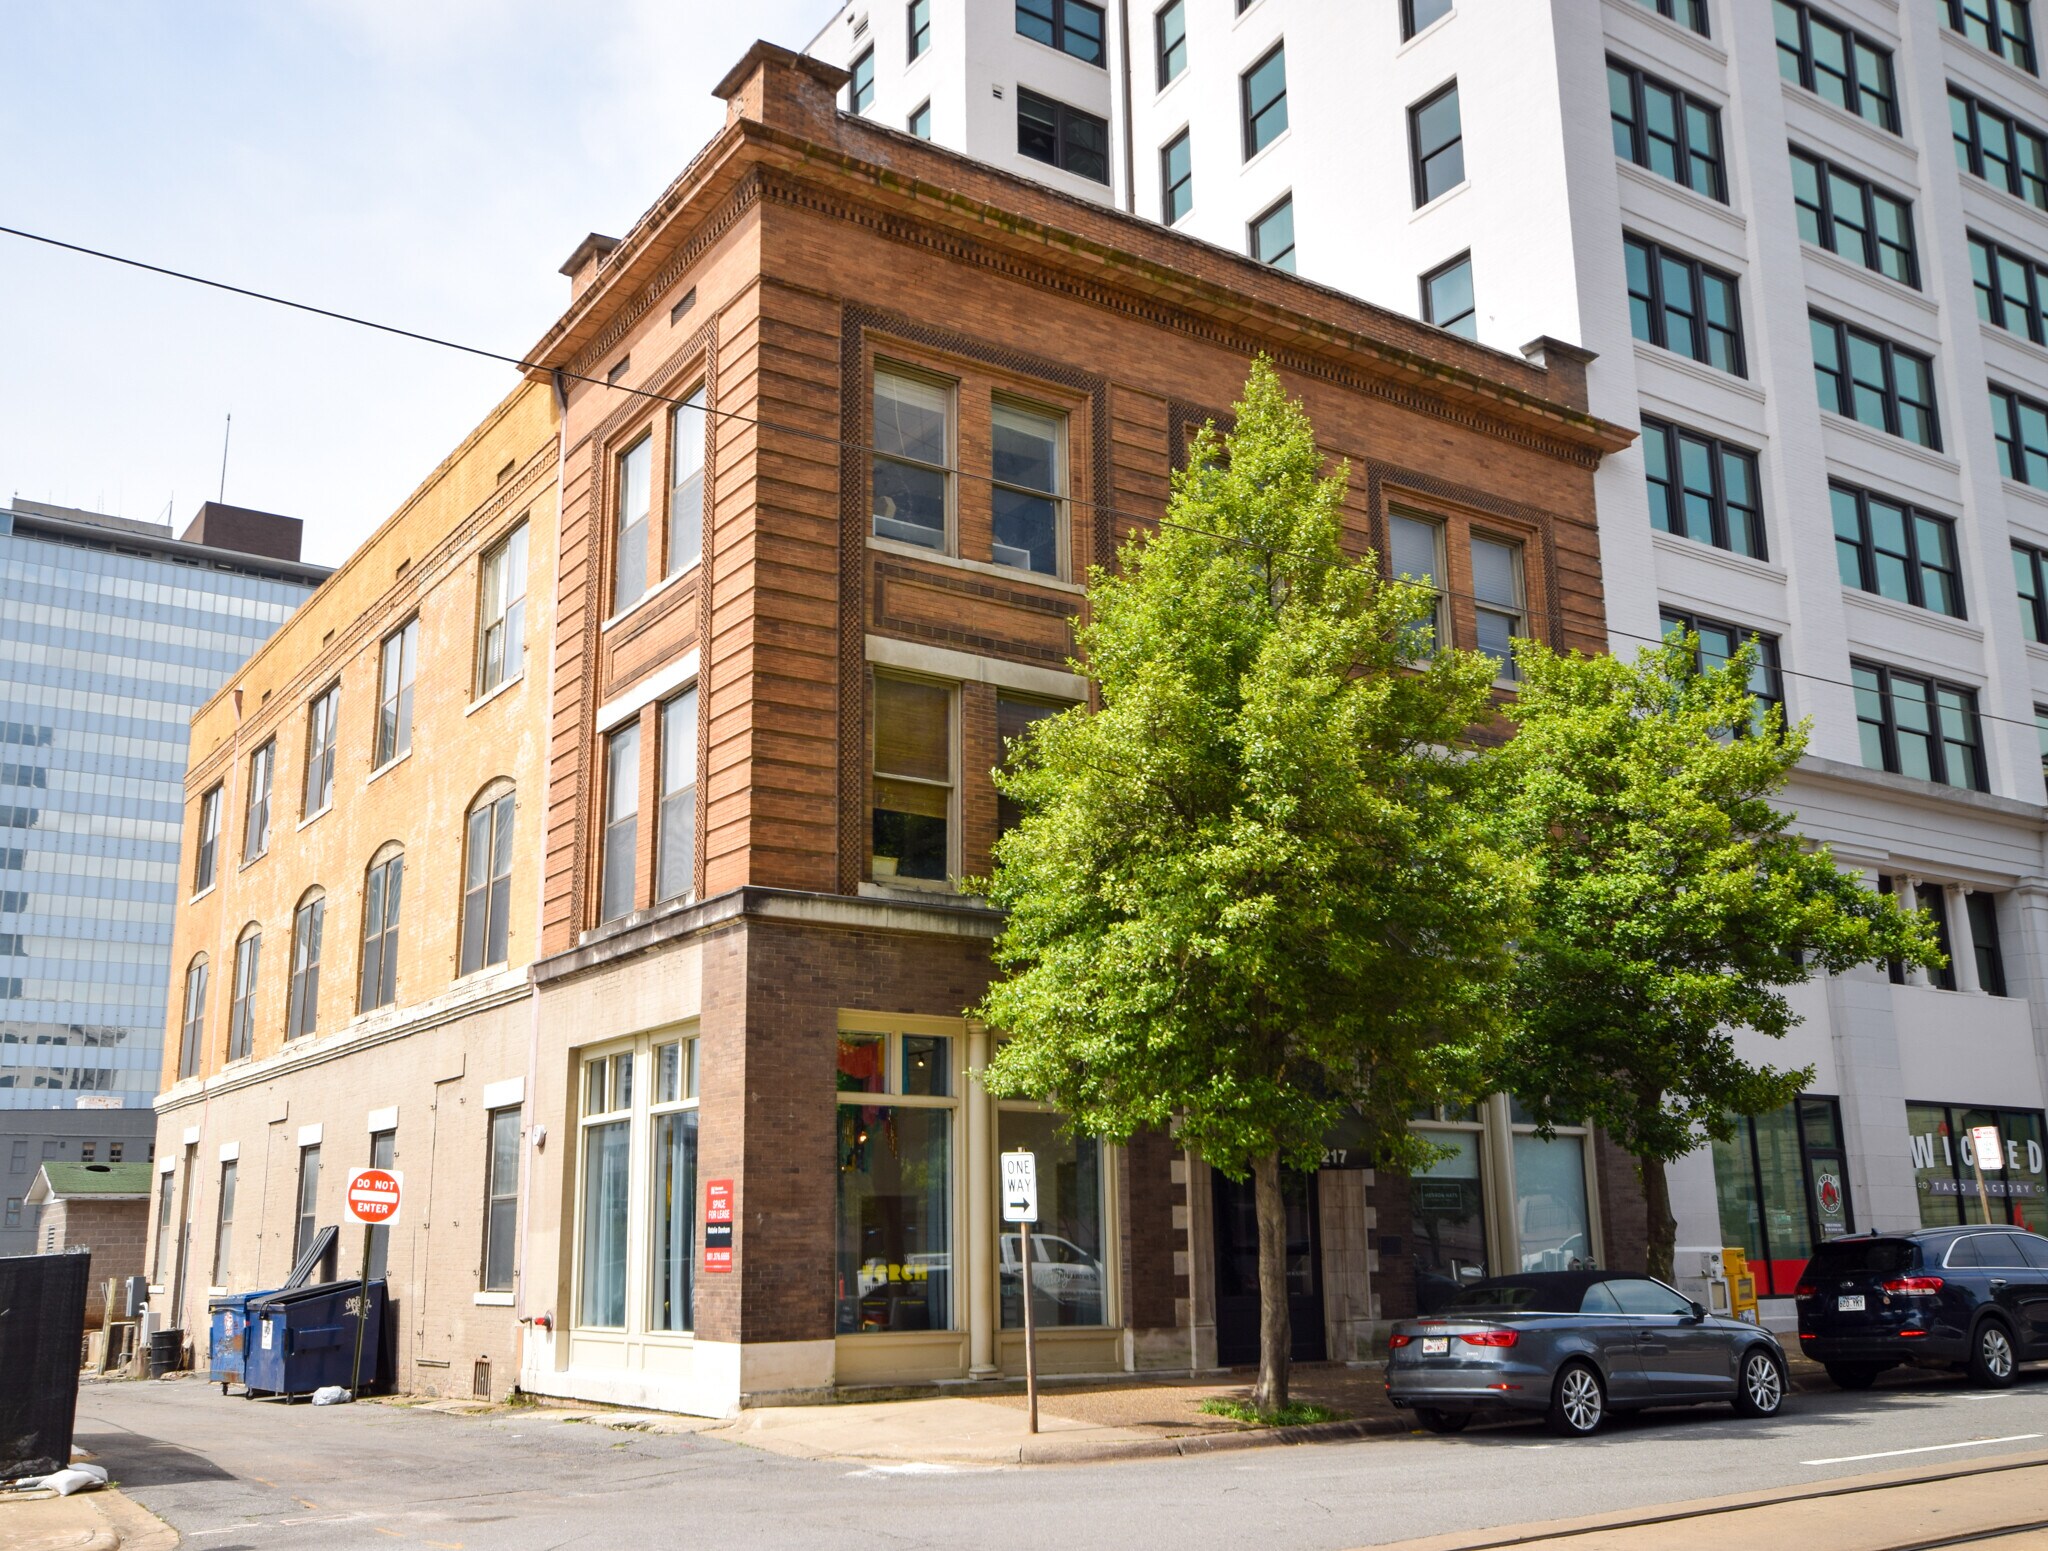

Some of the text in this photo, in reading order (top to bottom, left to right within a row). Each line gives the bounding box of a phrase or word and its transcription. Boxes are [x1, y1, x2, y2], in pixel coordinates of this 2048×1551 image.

[1909, 1133, 2043, 1174] WICED
[1007, 1160, 1031, 1175] ONE
[357, 1178, 395, 1190] DO NOT
[1007, 1178, 1031, 1192] WAY
[1934, 1182, 1966, 1192] TACO
[357, 1202, 389, 1214] ENTER
[712, 1199, 726, 1209] SPACE
[708, 1209, 730, 1219] FOR LEASE
